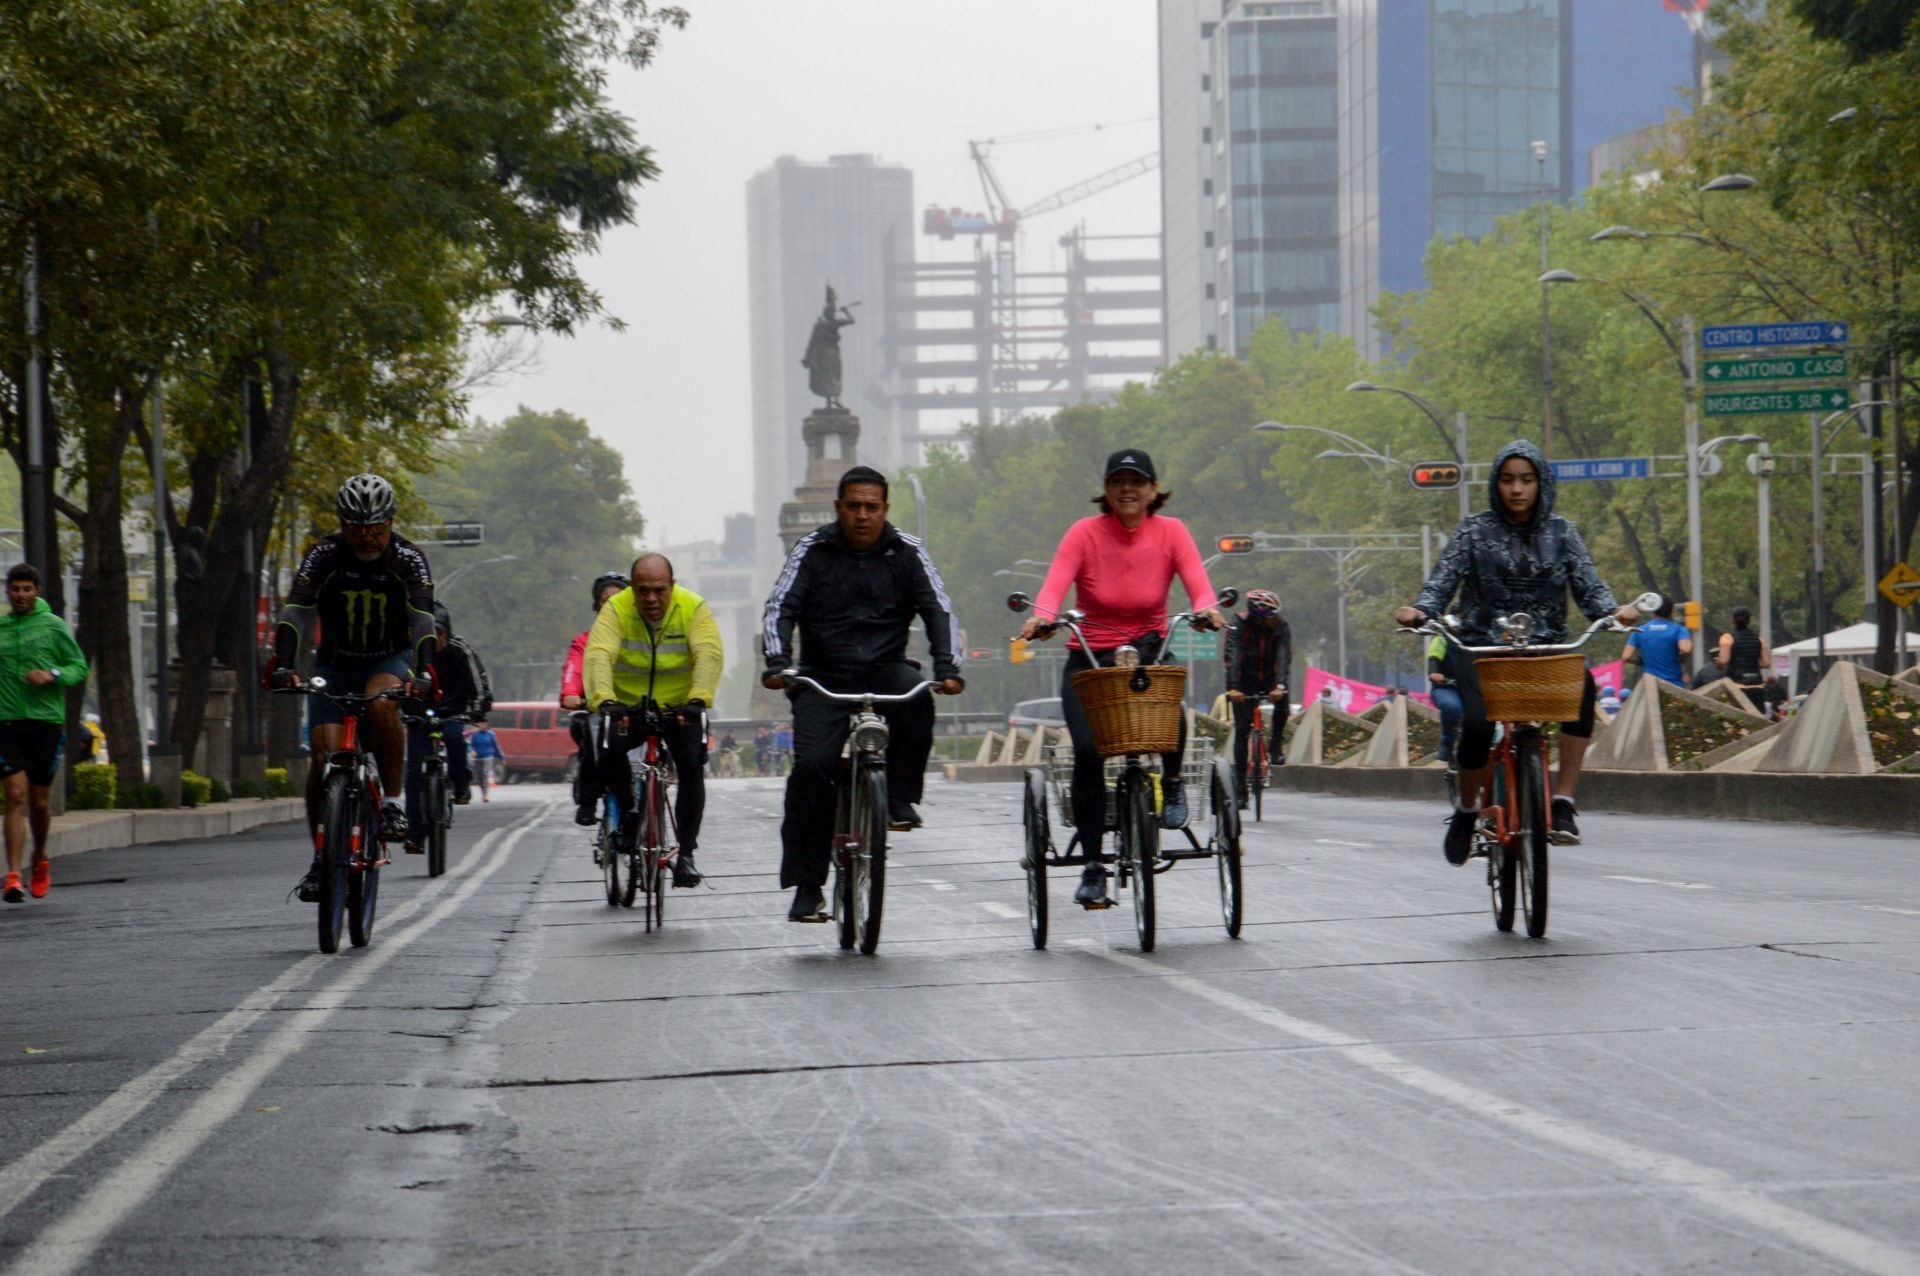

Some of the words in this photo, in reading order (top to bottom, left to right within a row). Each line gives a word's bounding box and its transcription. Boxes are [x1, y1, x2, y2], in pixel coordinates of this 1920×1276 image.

[1705, 330, 1753, 345] CENTRO
[1757, 326, 1820, 342] HISTORICO
[1728, 361, 1795, 378] ANTONIO
[1803, 359, 1844, 374] CASO
[1706, 395, 1792, 412] INSURGENTES
[1797, 394, 1823, 408] SUR
